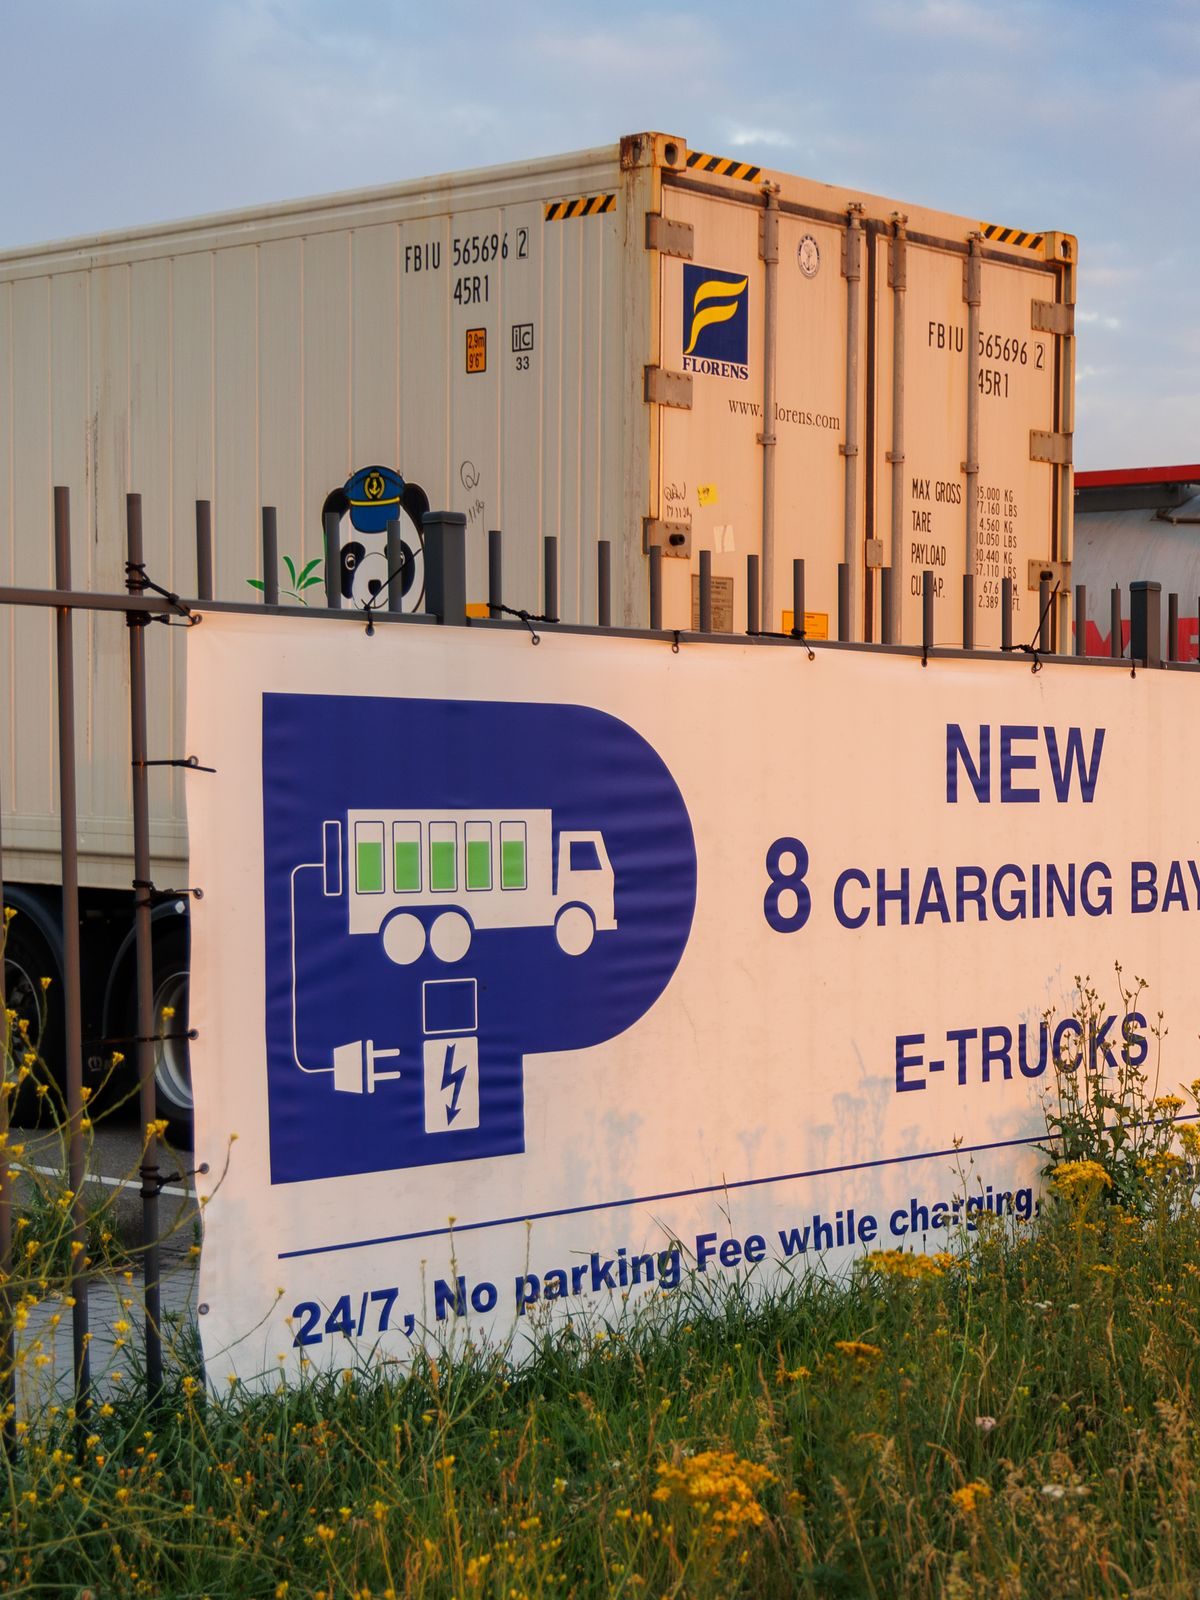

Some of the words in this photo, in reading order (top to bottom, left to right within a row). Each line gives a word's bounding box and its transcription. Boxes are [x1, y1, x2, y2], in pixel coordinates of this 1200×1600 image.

[405, 242, 441, 273] FBIU
[453, 233, 508, 266] 565696
[518, 230, 527, 257] 2
[453, 275, 489, 305] 45R1
[928, 321, 964, 353] FBIU
[978, 332, 1028, 365] 565696
[1036, 344, 1044, 369] 2
[516, 356, 530, 371] 33
[682, 356, 749, 380] FLORENS
[978, 368, 1009, 398] 45R1
[728, 399, 841, 431] www.lorens.com
[911, 478, 931, 501] MAX
[935, 481, 962, 504] GROSS
[1004, 489, 1014, 503] KG
[911, 510, 932, 533] TARE
[1003, 520, 1013, 534] KG
[1004, 504, 1018, 518] LBS
[911, 542, 947, 567] PAYLOAD
[1003, 551, 1013, 565] KG
[1003, 535, 1017, 548] LBS
[1003, 565, 1017, 580] LBS
[932, 577, 946, 599] AP.
[978, 594, 999, 609] 2.389
[945, 723, 1106, 804] NEW
[763, 836, 812, 934] 8
[833, 860, 1113, 929] CHARGING
[895, 1012, 1149, 1093] E-TRUCKS
[292, 1286, 416, 1348] 24/7,
[434, 1275, 498, 1321] No
[515, 1246, 681, 1317] parking
[696, 1232, 767, 1273] Fee
[778, 1208, 878, 1257] while
